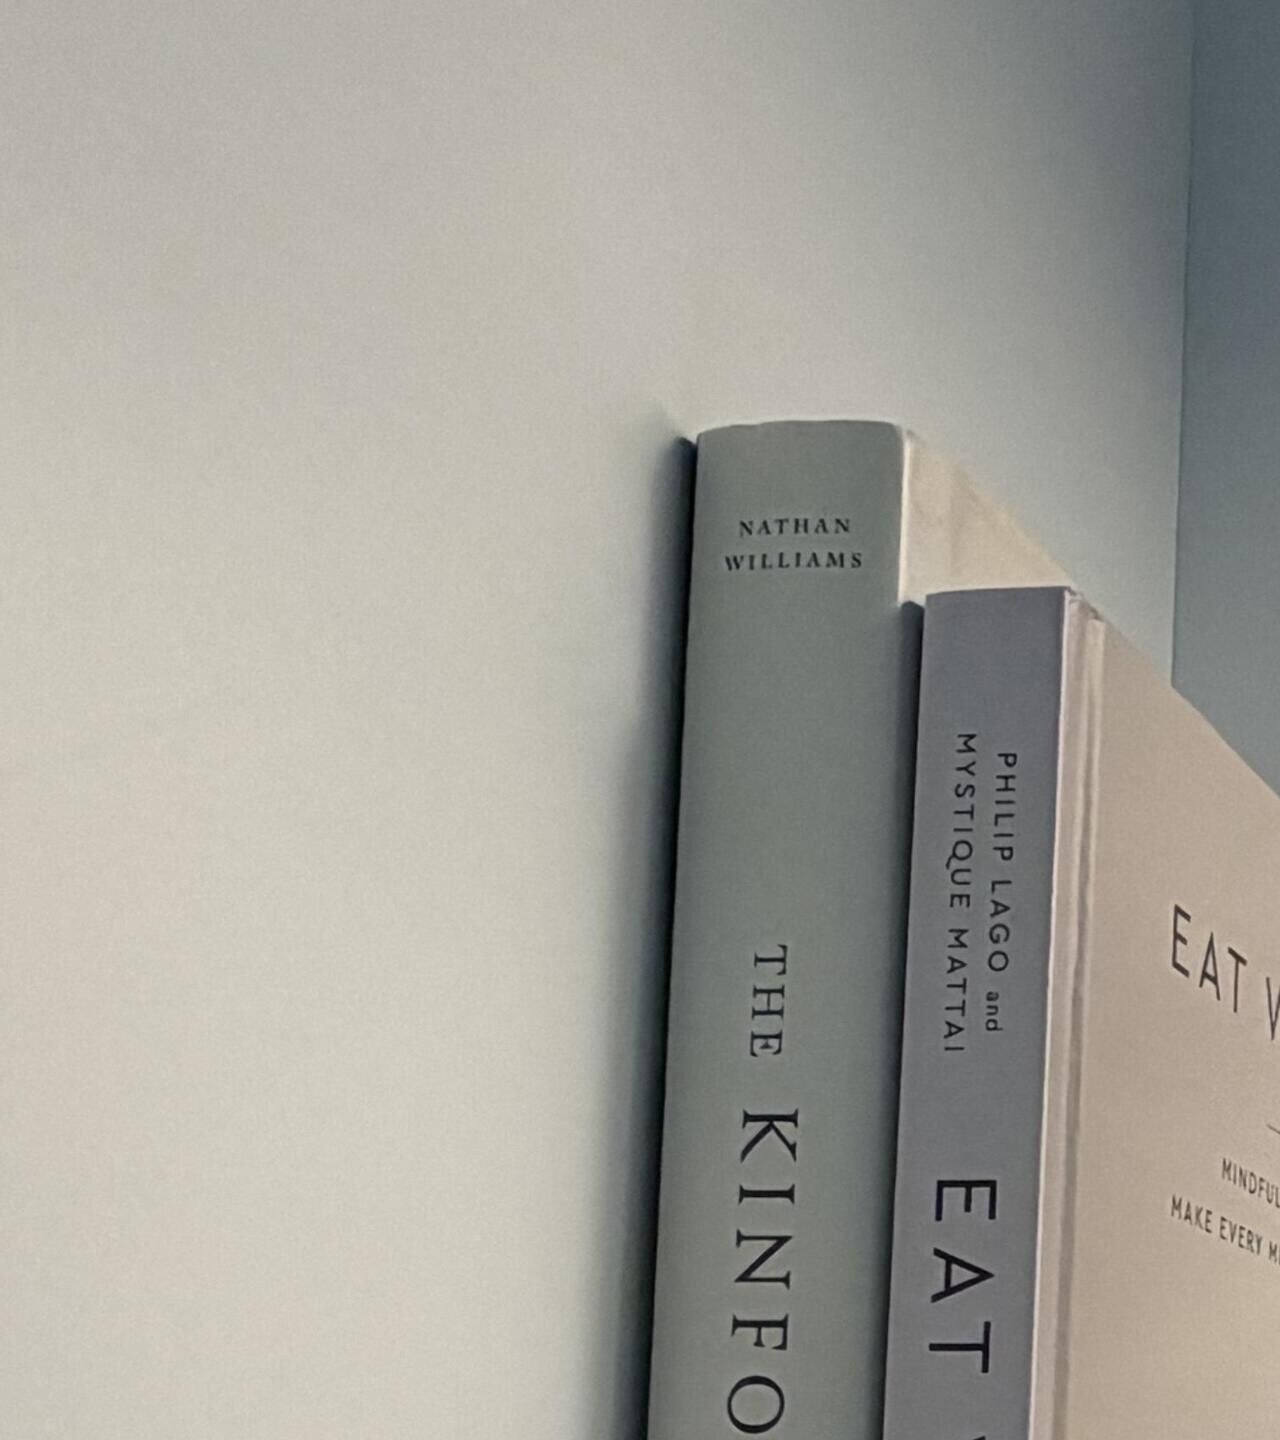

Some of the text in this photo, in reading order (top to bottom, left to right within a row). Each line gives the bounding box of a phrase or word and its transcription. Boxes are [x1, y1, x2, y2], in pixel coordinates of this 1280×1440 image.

[725, 552, 862, 571] WILLIAMS
[739, 518, 850, 537] NATHAN
[944, 733, 977, 1051] MYSTIQUE MATTAI
[985, 753, 1017, 1032] PHILIP LAGO and
[748, 944, 788, 1058] THE
[1171, 904, 1248, 1013] EAT
[1171, 1195, 1213, 1233] MAKE
[1219, 1216, 1263, 1255] EVERY
[1222, 1158, 1280, 1208] MINDFUL
[928, 1179, 997, 1374] EAT
